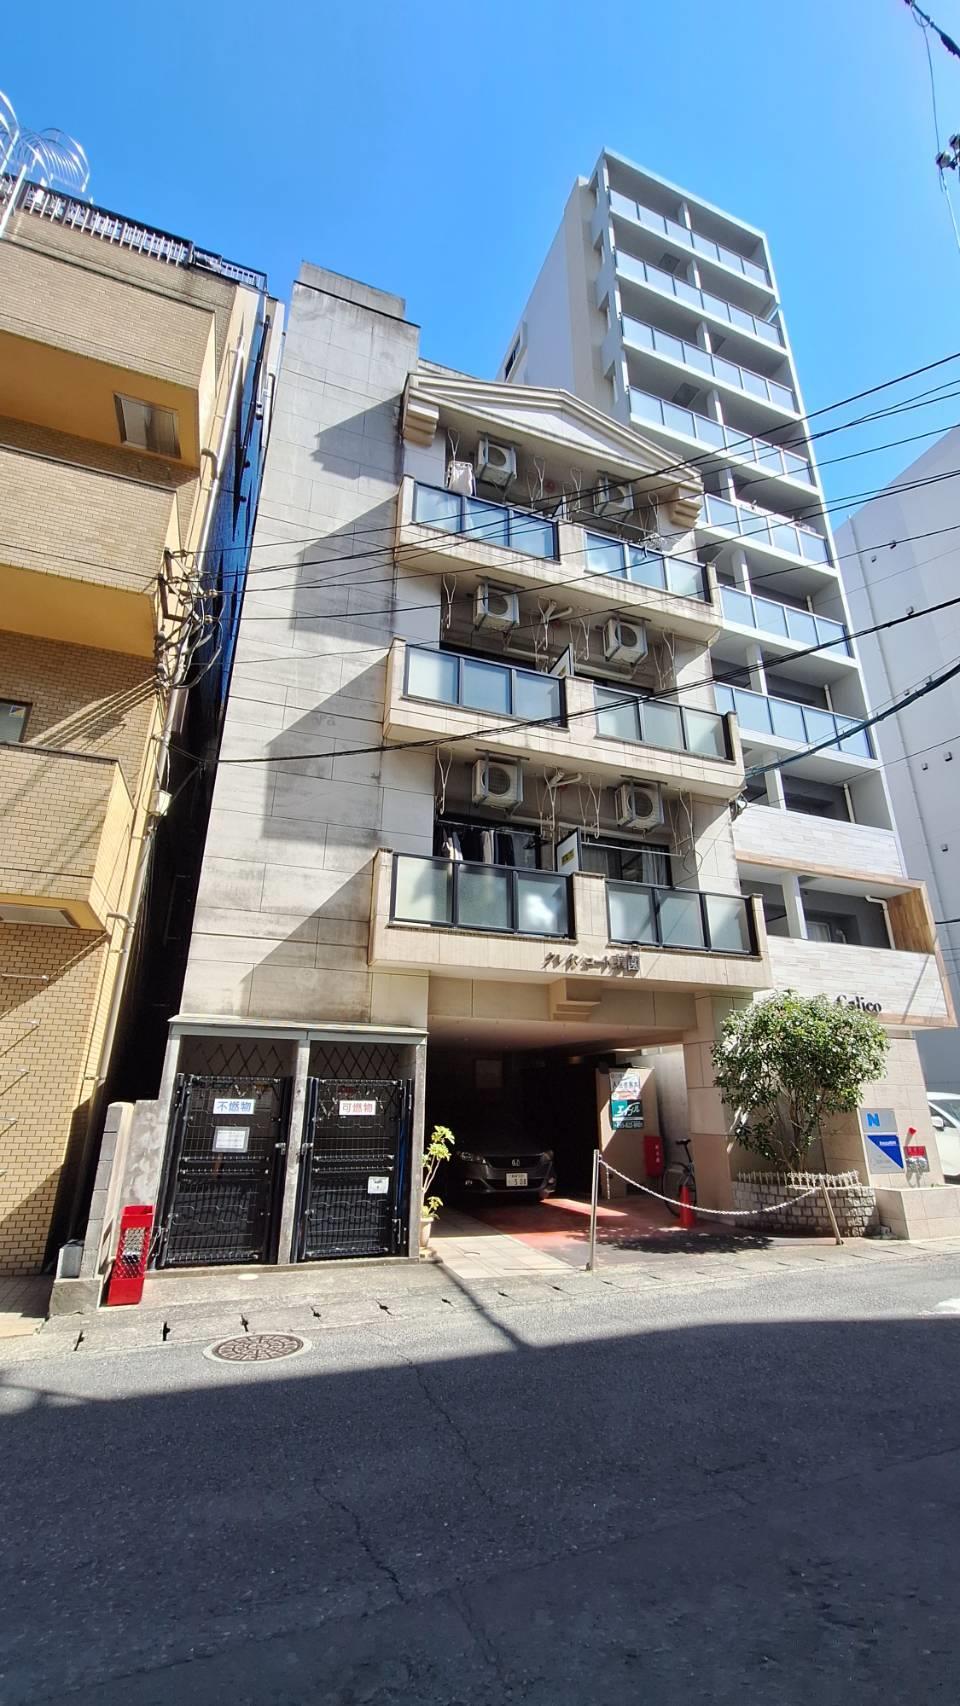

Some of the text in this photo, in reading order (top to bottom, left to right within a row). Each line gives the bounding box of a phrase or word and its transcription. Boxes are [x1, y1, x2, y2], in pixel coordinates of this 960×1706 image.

[836, 994, 882, 1013] Calico
[216, 1100, 252, 1113] 不燃物
[342, 1102, 373, 1113] 可燃物
